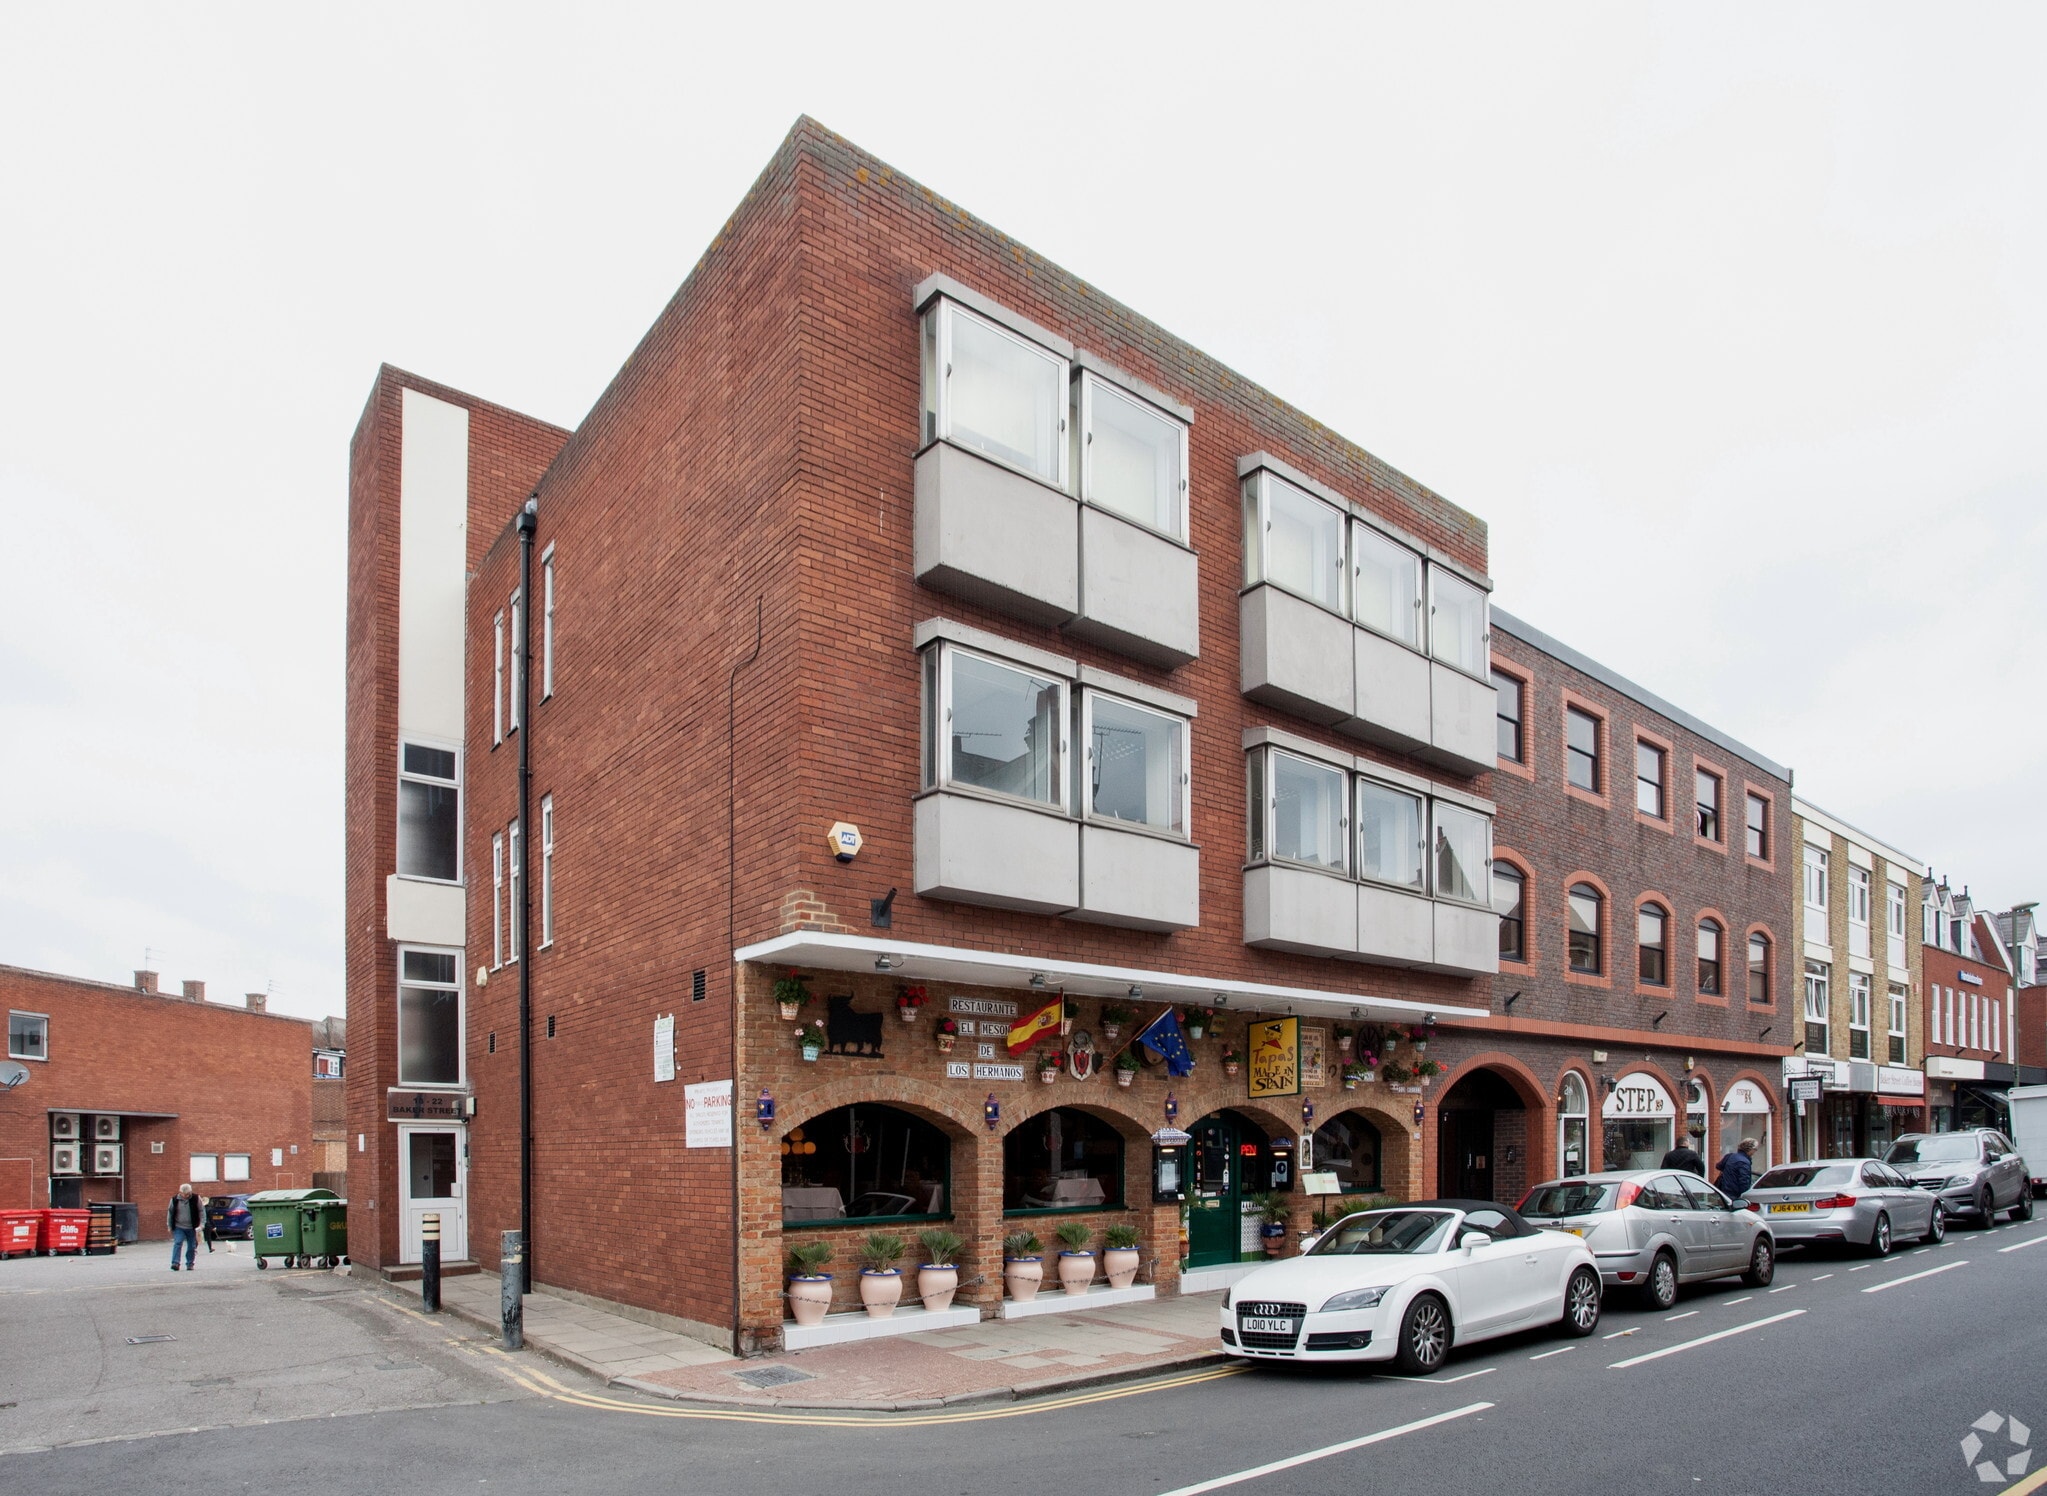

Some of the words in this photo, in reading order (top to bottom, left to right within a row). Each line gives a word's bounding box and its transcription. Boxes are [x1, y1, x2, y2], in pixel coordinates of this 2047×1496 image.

[952, 999, 1016, 1015] RESTAURANTE
[961, 1022, 973, 1033] EL
[980, 1045, 993, 1056] DE
[1252, 1046, 1294, 1071] Tapas
[949, 1065, 968, 1076] LOS
[976, 1066, 1022, 1078] HERMANOS
[1253, 1065, 1281, 1078] MADE
[1283, 1063, 1295, 1076] IN
[1252, 1077, 1294, 1092] SPAIN
[432, 1097, 443, 1105] 22
[685, 1098, 695, 1110] NO
[703, 1094, 731, 1108] PARKING
[1616, 1087, 1656, 1113] STEP
[392, 1106, 425, 1114] BAKER
[427, 1107, 463, 1115] STREET
[1247, 1319, 1266, 1330] LO10
[1268, 1319, 1286, 1331] YLC
